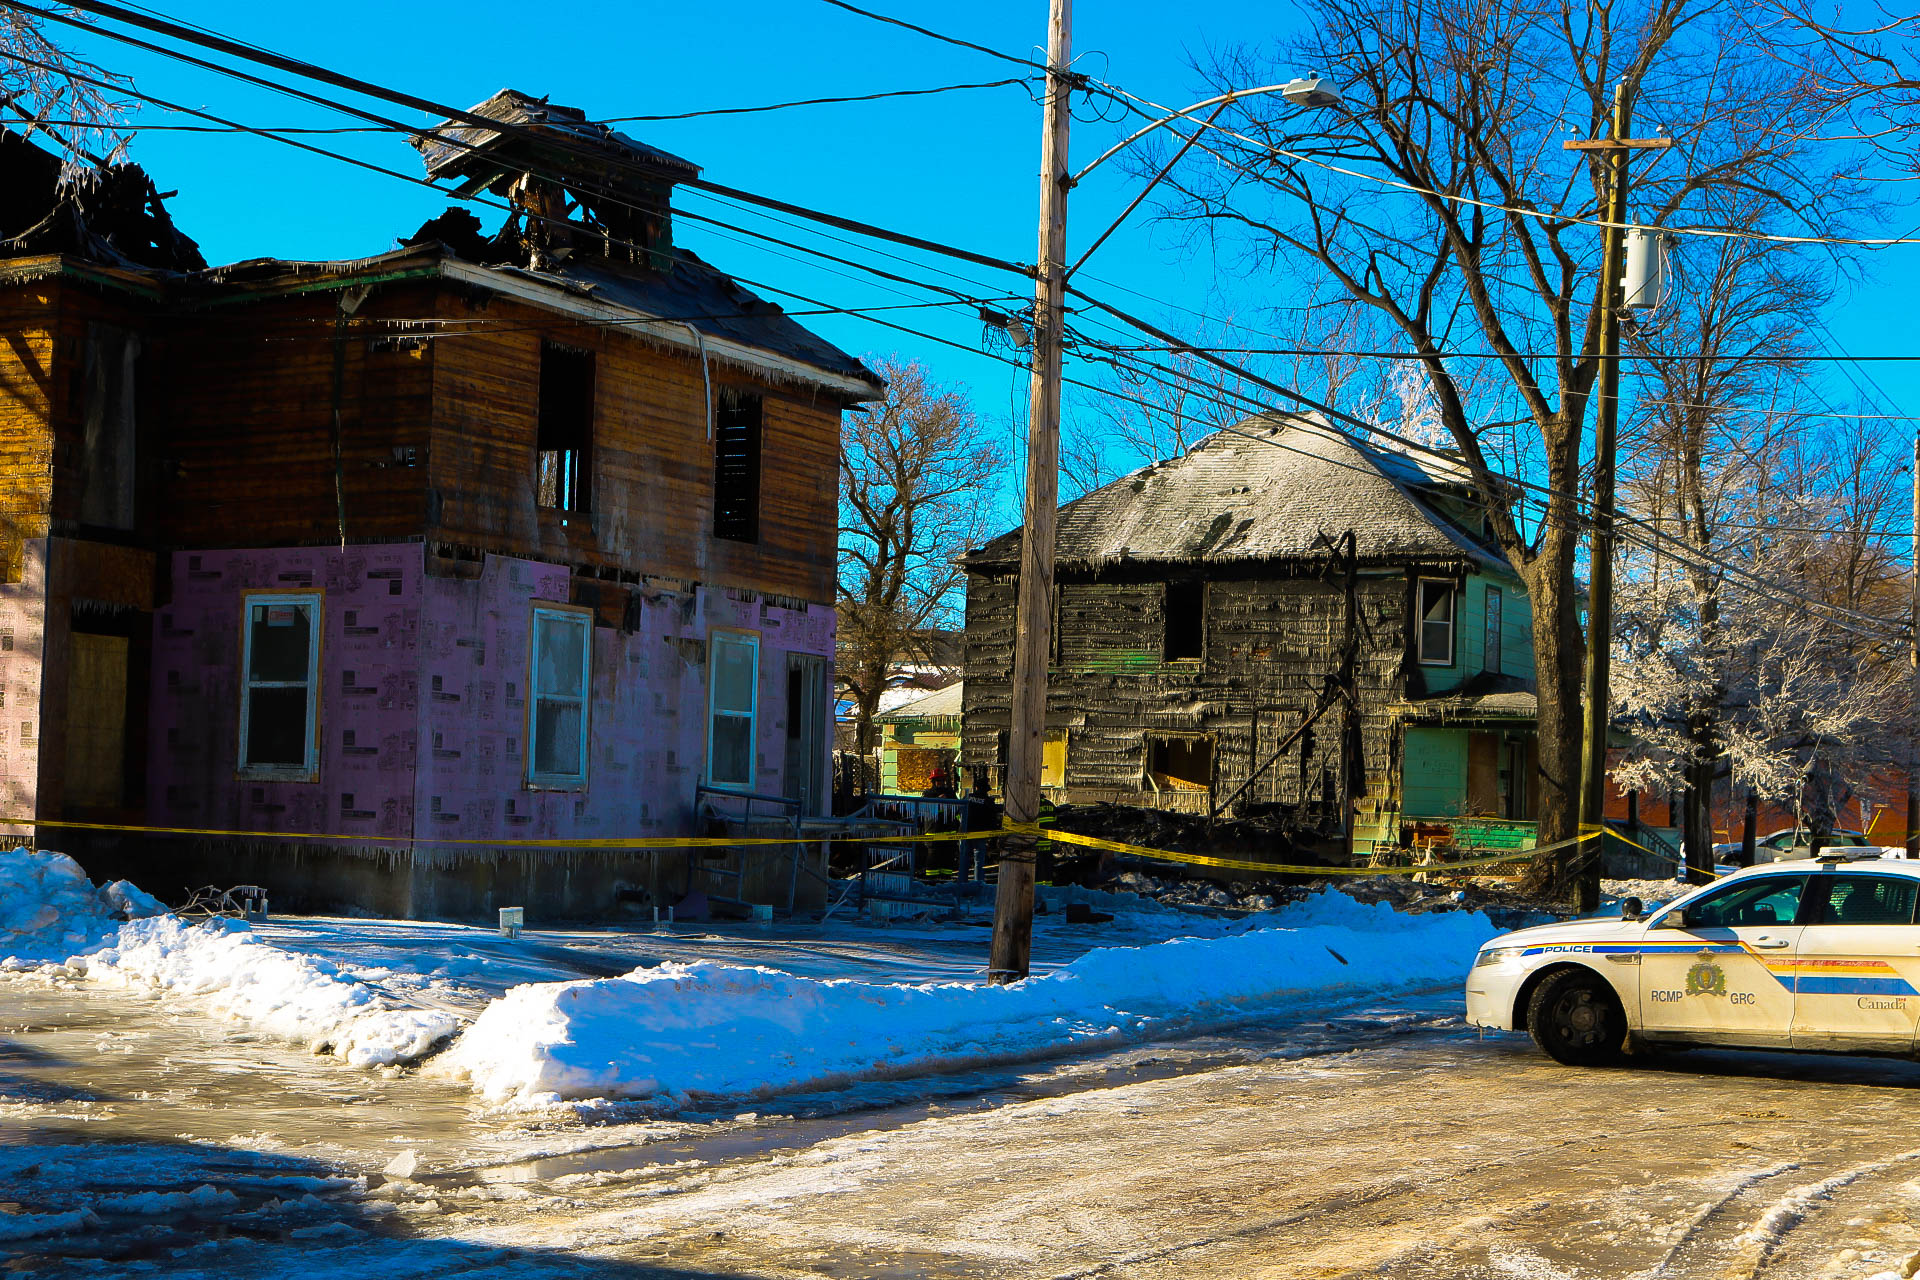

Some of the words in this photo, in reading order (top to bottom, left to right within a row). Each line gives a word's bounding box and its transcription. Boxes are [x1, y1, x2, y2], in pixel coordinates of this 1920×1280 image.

[1545, 945, 1592, 953] POLICE
[1651, 990, 1683, 1003] RCMP
[1730, 993, 1756, 1005] GRC
[1857, 996, 1906, 1010] Canada
